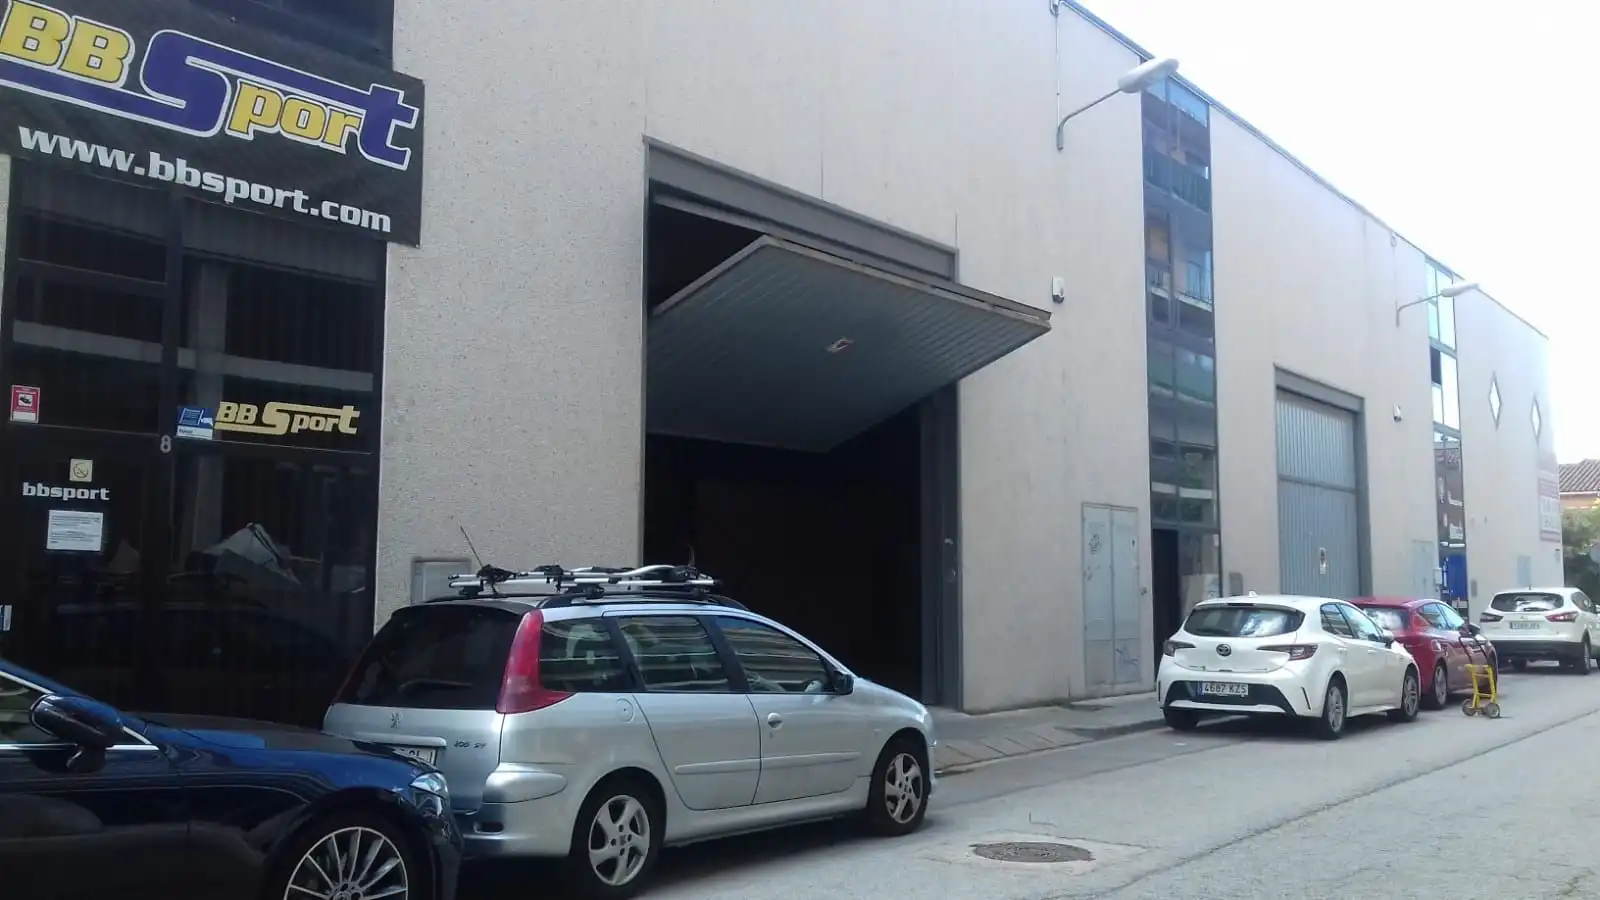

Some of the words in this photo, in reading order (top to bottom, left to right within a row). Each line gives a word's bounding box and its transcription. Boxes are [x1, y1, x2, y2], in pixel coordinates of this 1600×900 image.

[0, 0, 135, 88] BB
[140, 29, 420, 171] Sport
[18, 126, 392, 233] www.bbsport.com
[215, 401, 259, 425] BB
[262, 401, 361, 435] Sport
[160, 435, 172, 453] 8
[22, 482, 110, 501] bbsport
